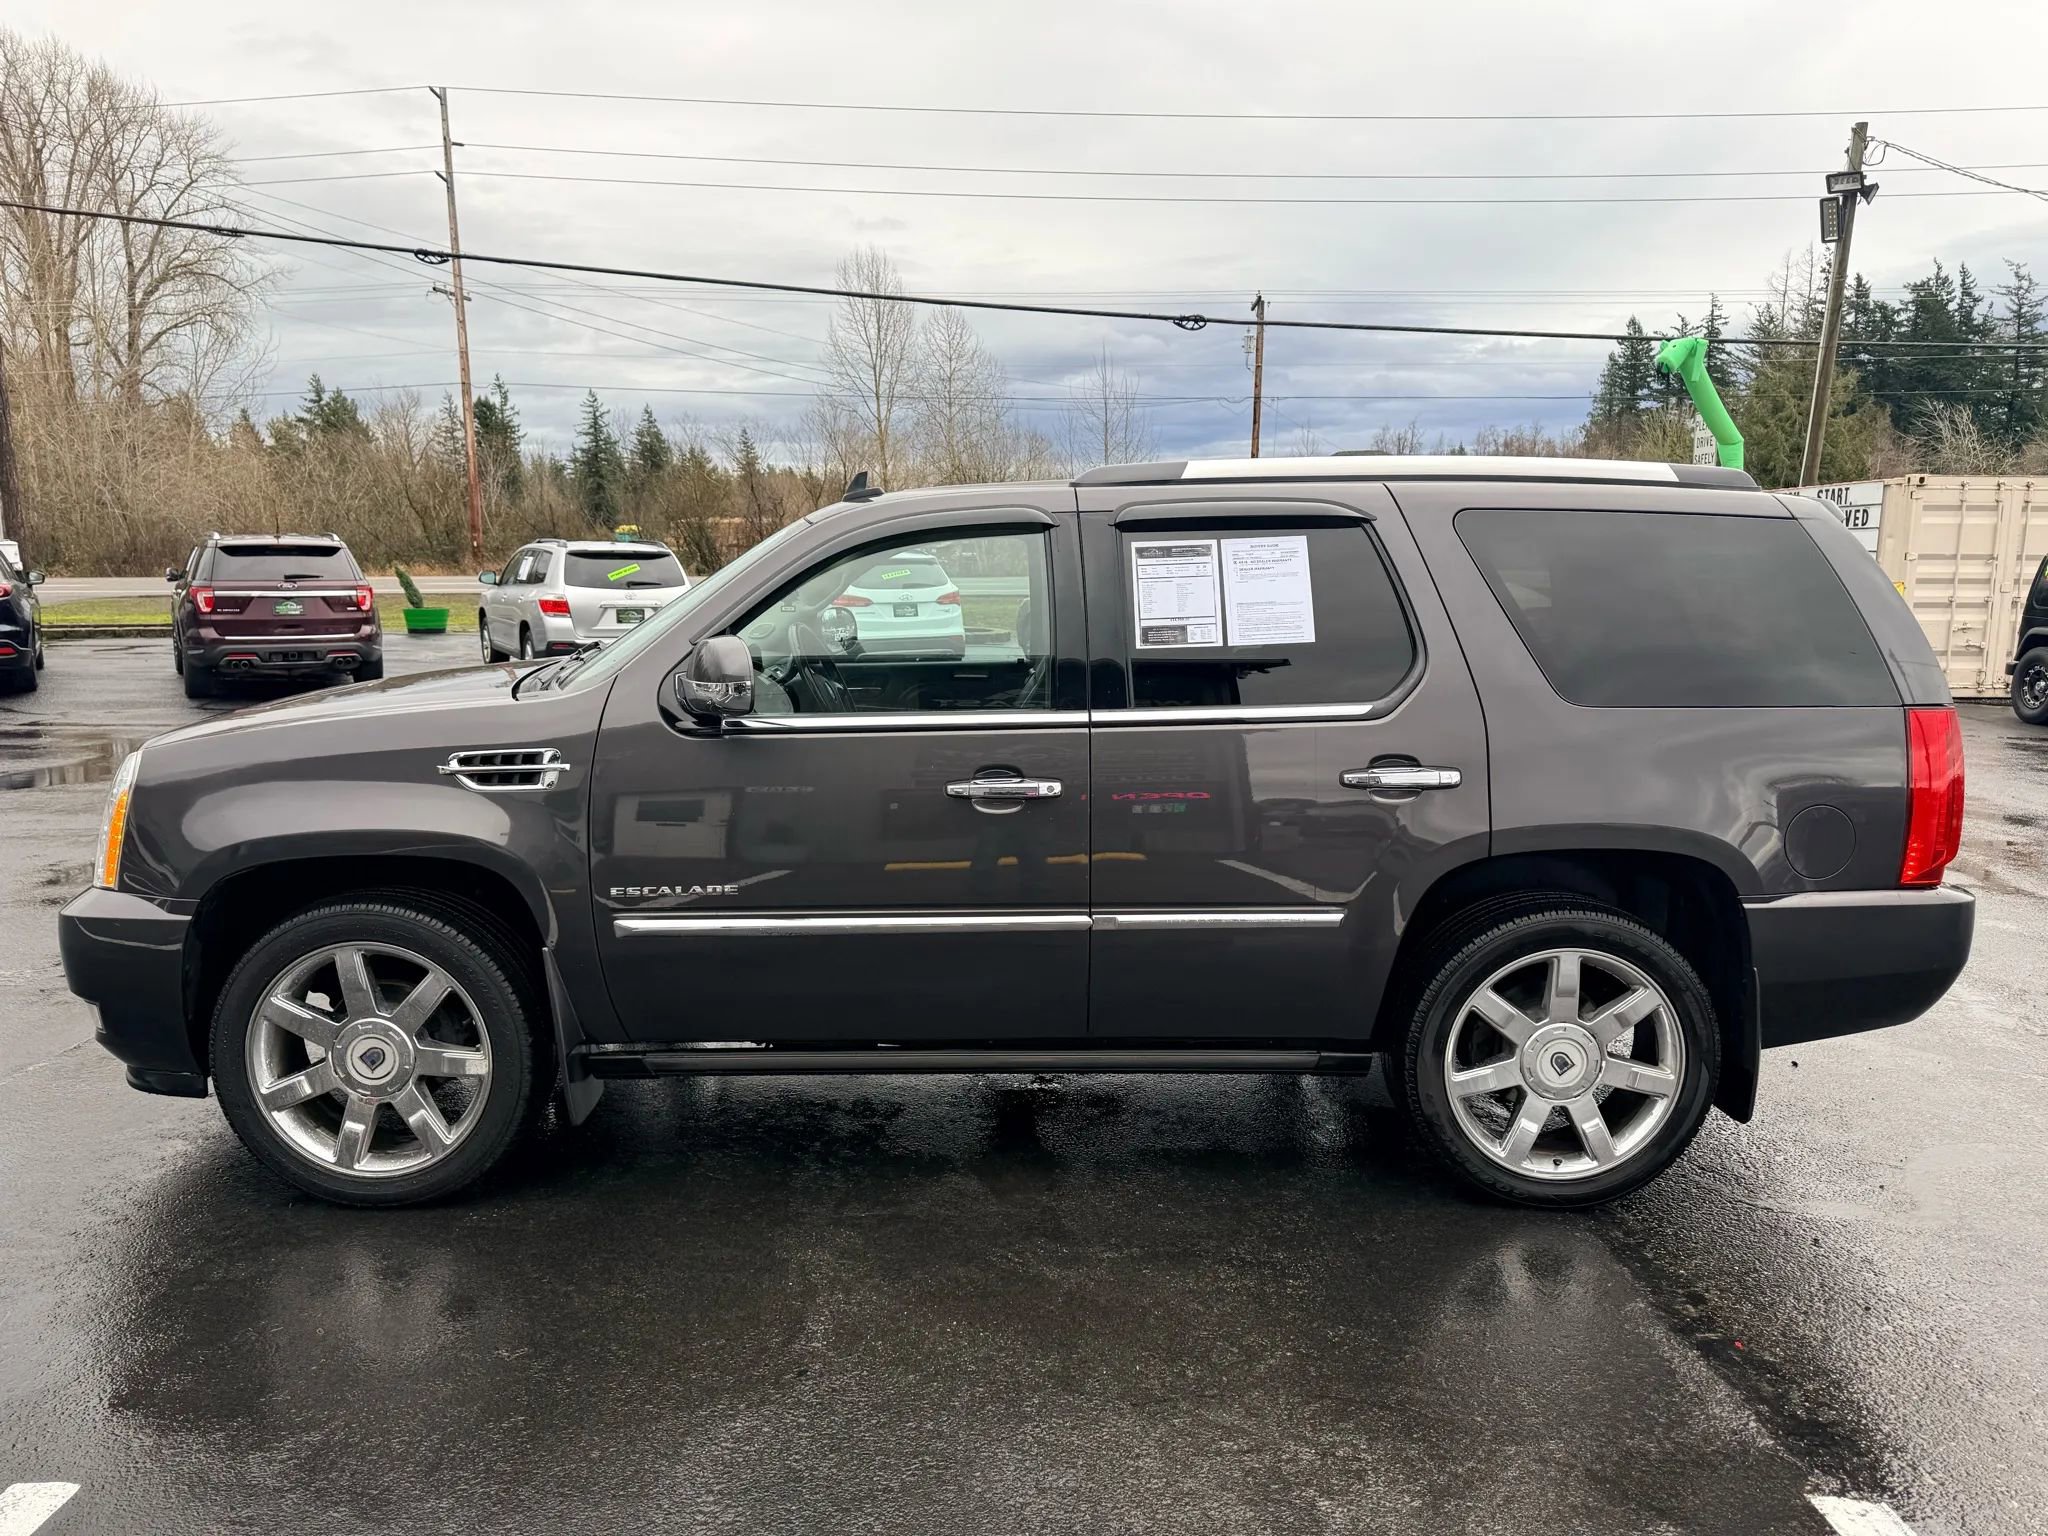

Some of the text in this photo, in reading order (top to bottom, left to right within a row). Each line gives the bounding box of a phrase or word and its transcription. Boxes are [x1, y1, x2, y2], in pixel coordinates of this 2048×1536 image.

[1696, 435, 1714, 448] DRIVE
[1694, 452, 1715, 465] SAFELY
[1843, 509, 1869, 527] VED
[610, 885, 739, 897] ESCALADE
